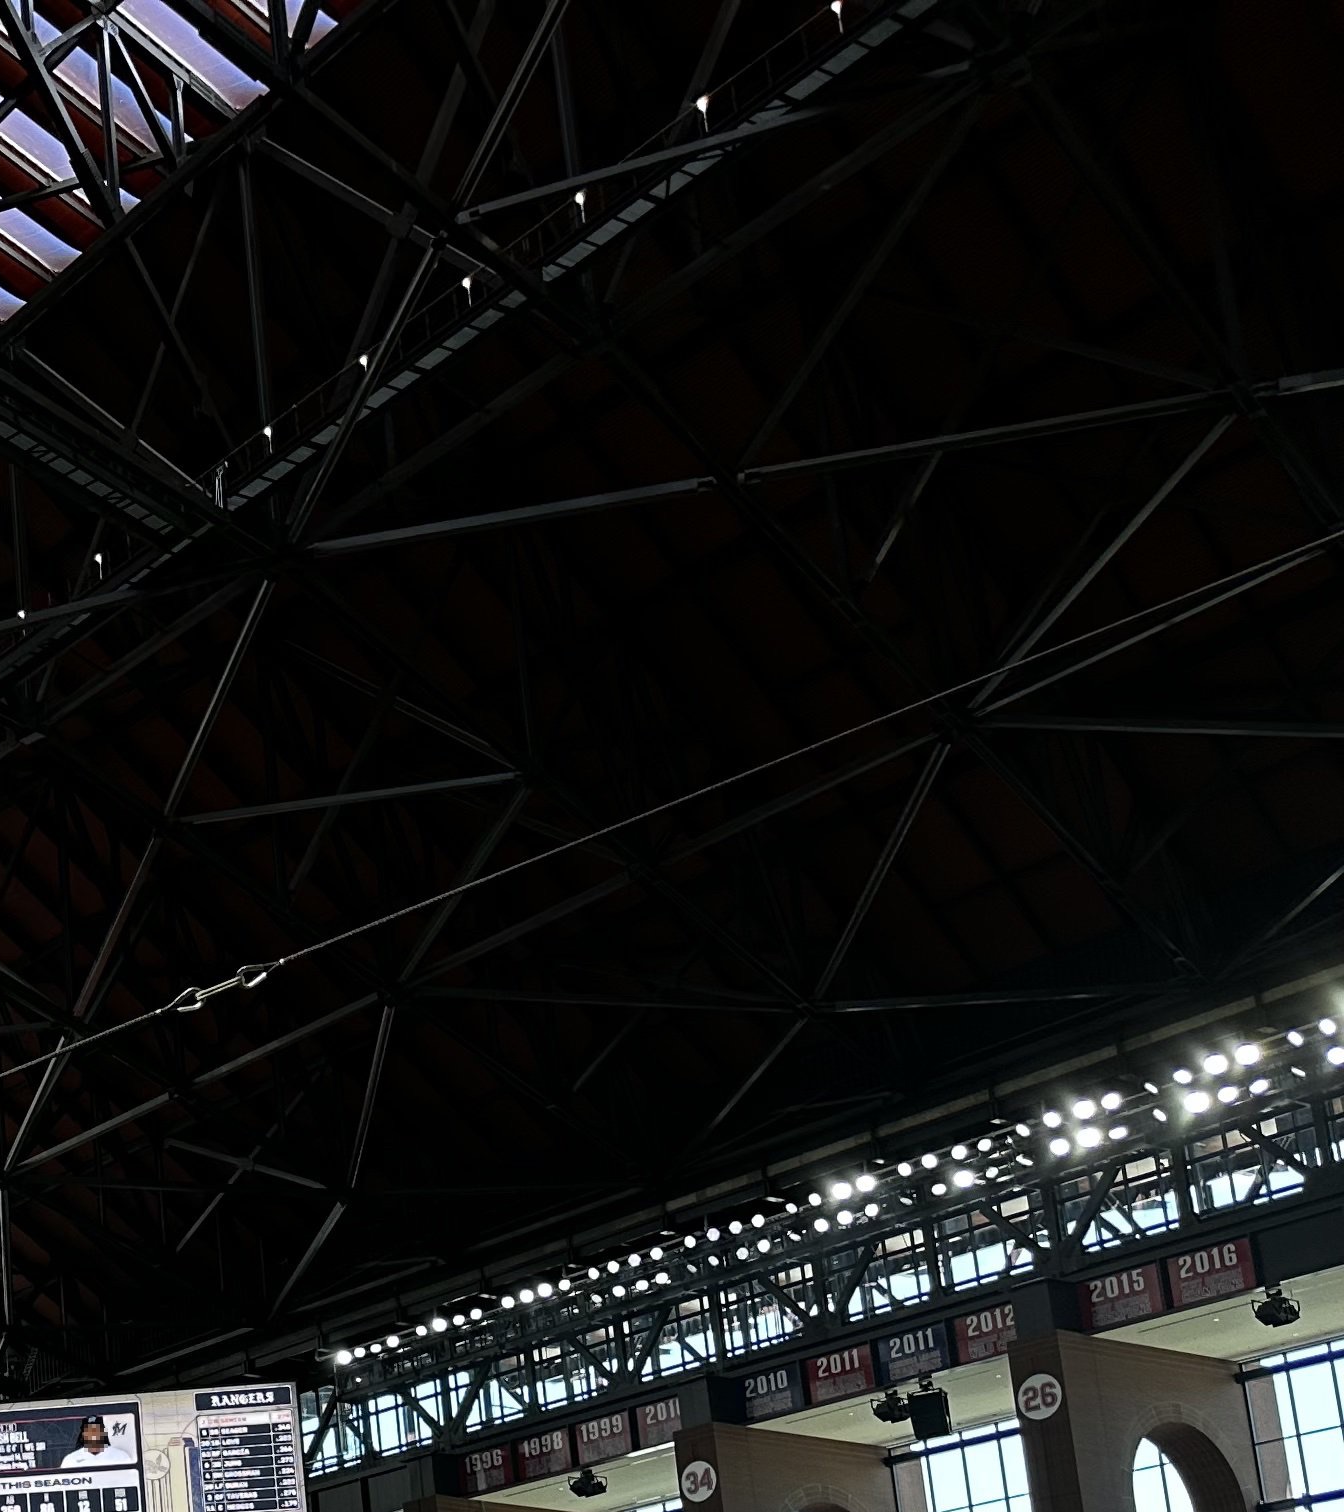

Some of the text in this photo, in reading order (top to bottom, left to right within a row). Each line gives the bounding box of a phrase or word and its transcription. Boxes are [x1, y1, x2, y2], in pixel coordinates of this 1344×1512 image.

[1178, 1243, 1238, 1279] 2016
[1089, 1268, 1145, 1303] 2015
[966, 1304, 1015, 1337] 2012
[889, 1328, 934, 1359] 2011
[816, 1348, 860, 1378] 2011
[744, 1370, 788, 1398] 2010
[1022, 1380, 1058, 1413] 26
[211, 1391, 275, 1408] RANGERS
[580, 1414, 623, 1443] 1999
[523, 1431, 562, 1458] 1998
[465, 1449, 503, 1474] 1996
[0, 1477, 93, 1490] THIS SEASON
[684, 1467, 714, 1494] 34
[114, 1498, 128, 1512] 51
